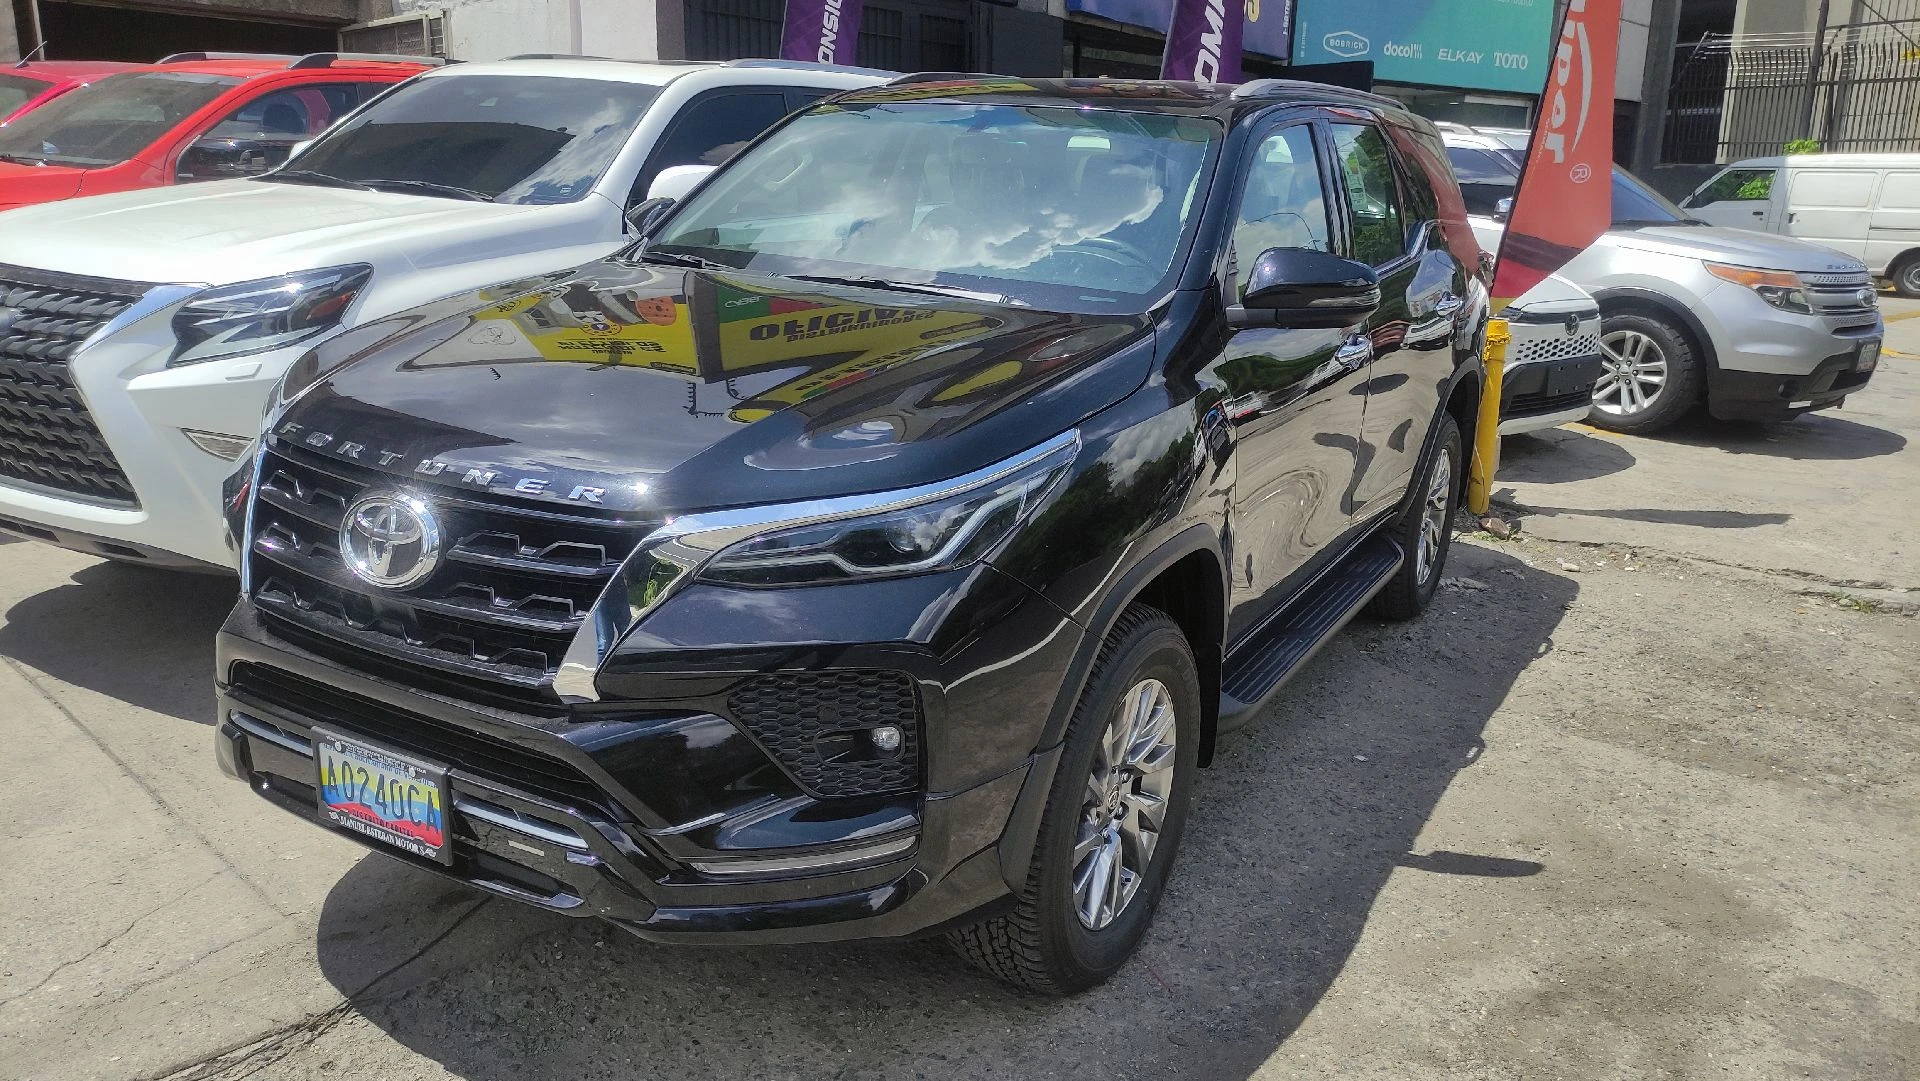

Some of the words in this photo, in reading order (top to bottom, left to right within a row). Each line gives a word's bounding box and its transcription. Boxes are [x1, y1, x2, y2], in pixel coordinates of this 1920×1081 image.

[1329, 38, 1364, 50] BOBRICK
[1438, 48, 1484, 64] ELKAY
[1493, 52, 1528, 70] TOTO
[278, 421, 608, 505] FORTUNER
